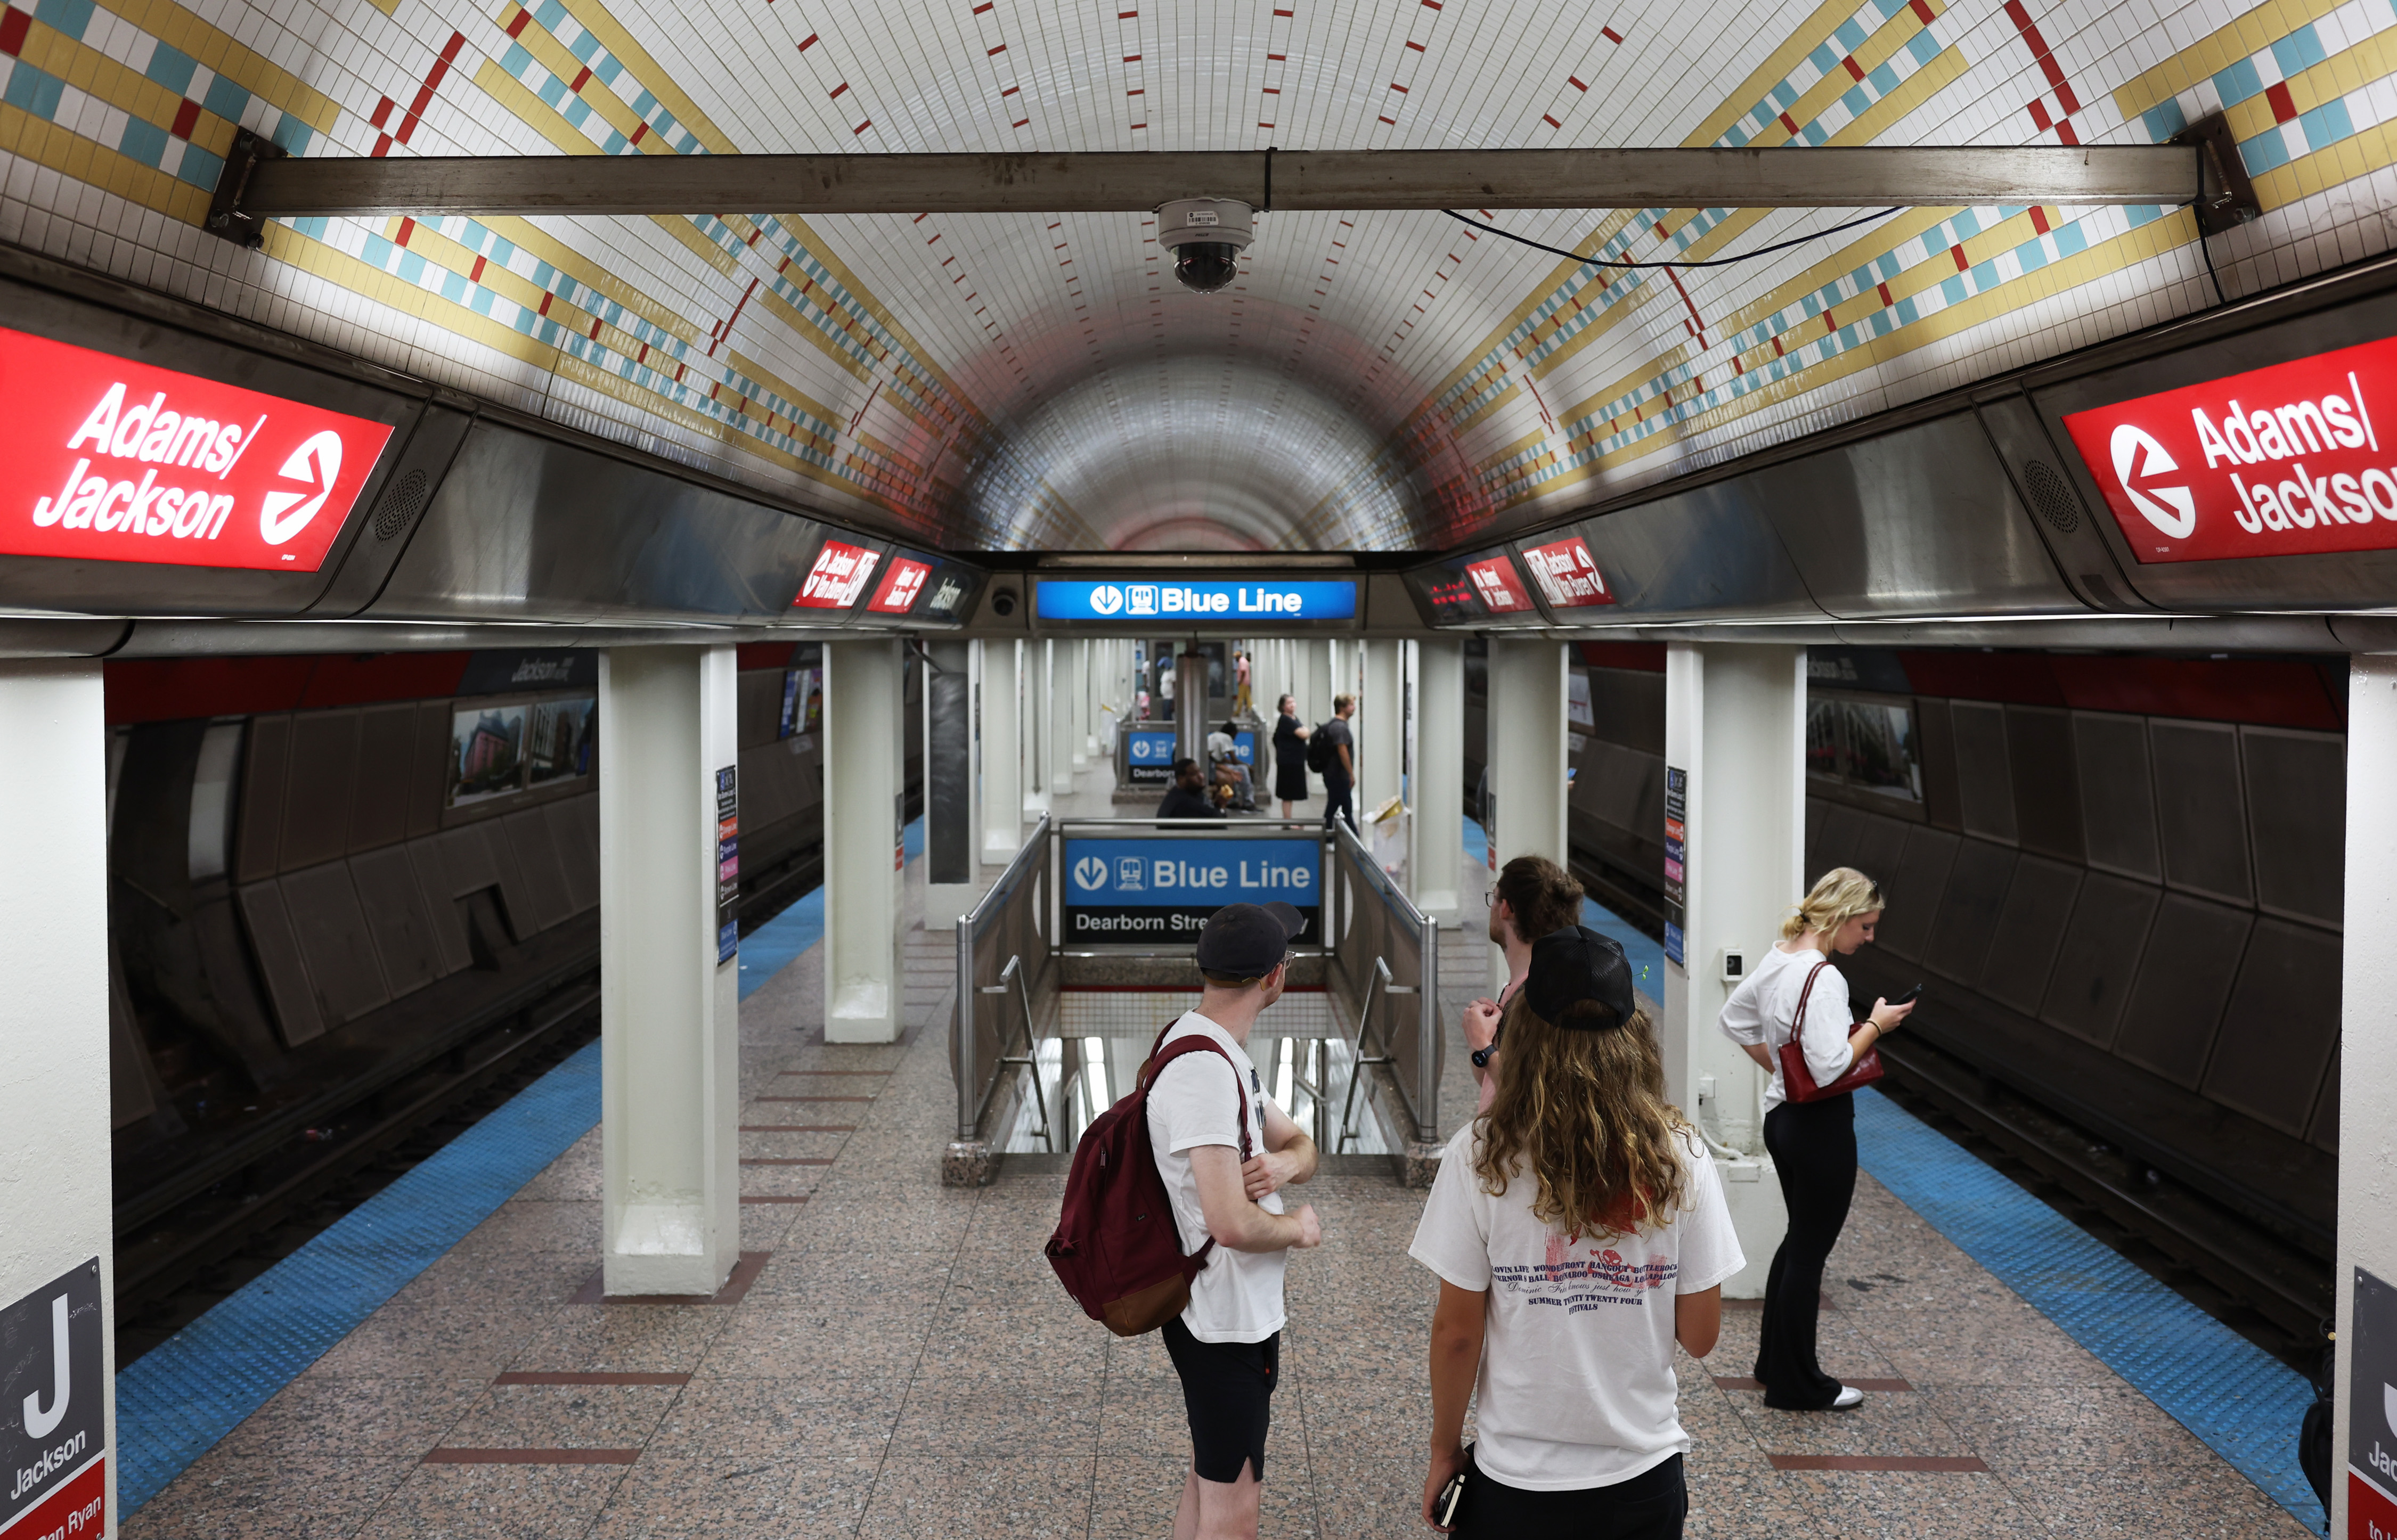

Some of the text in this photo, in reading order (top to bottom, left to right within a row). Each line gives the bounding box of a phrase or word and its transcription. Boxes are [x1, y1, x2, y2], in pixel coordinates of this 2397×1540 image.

[67, 382, 267, 480] Adams/
[2191, 371, 2378, 469] Adams/
[32, 458, 234, 540] Jackson
[2229, 463, 2397, 534] Jackso
[826, 550, 860, 578] Jackson/
[1544, 547, 1578, 575] Jackson/
[813, 575, 848, 600] Van Buren
[1554, 574, 1595, 597] Van Buren
[1162, 588, 1302, 612] Blue Line
[1154, 861, 1310, 888] Blue Line
[1077, 914, 1208, 930] Dearborn Stre
[1528, 1274, 1549, 1283] BALL
[1592, 1272, 1630, 1282] OSHEAGA
[1591, 1262, 1629, 1273] HANGOUT
[1506, 1282, 1543, 1294] Dominic
[1568, 1280, 1590, 1290] knows
[1590, 1282, 1610, 1293] just
[1612, 1284, 1631, 1293] how
[1529, 1297, 1562, 1306] SUMMER
[1585, 1294, 1619, 1304] TWENTY
[23, 1293, 70, 1439] J
[11, 1430, 86, 1501] Jackson
[68, 1496, 101, 1535] Ryan
